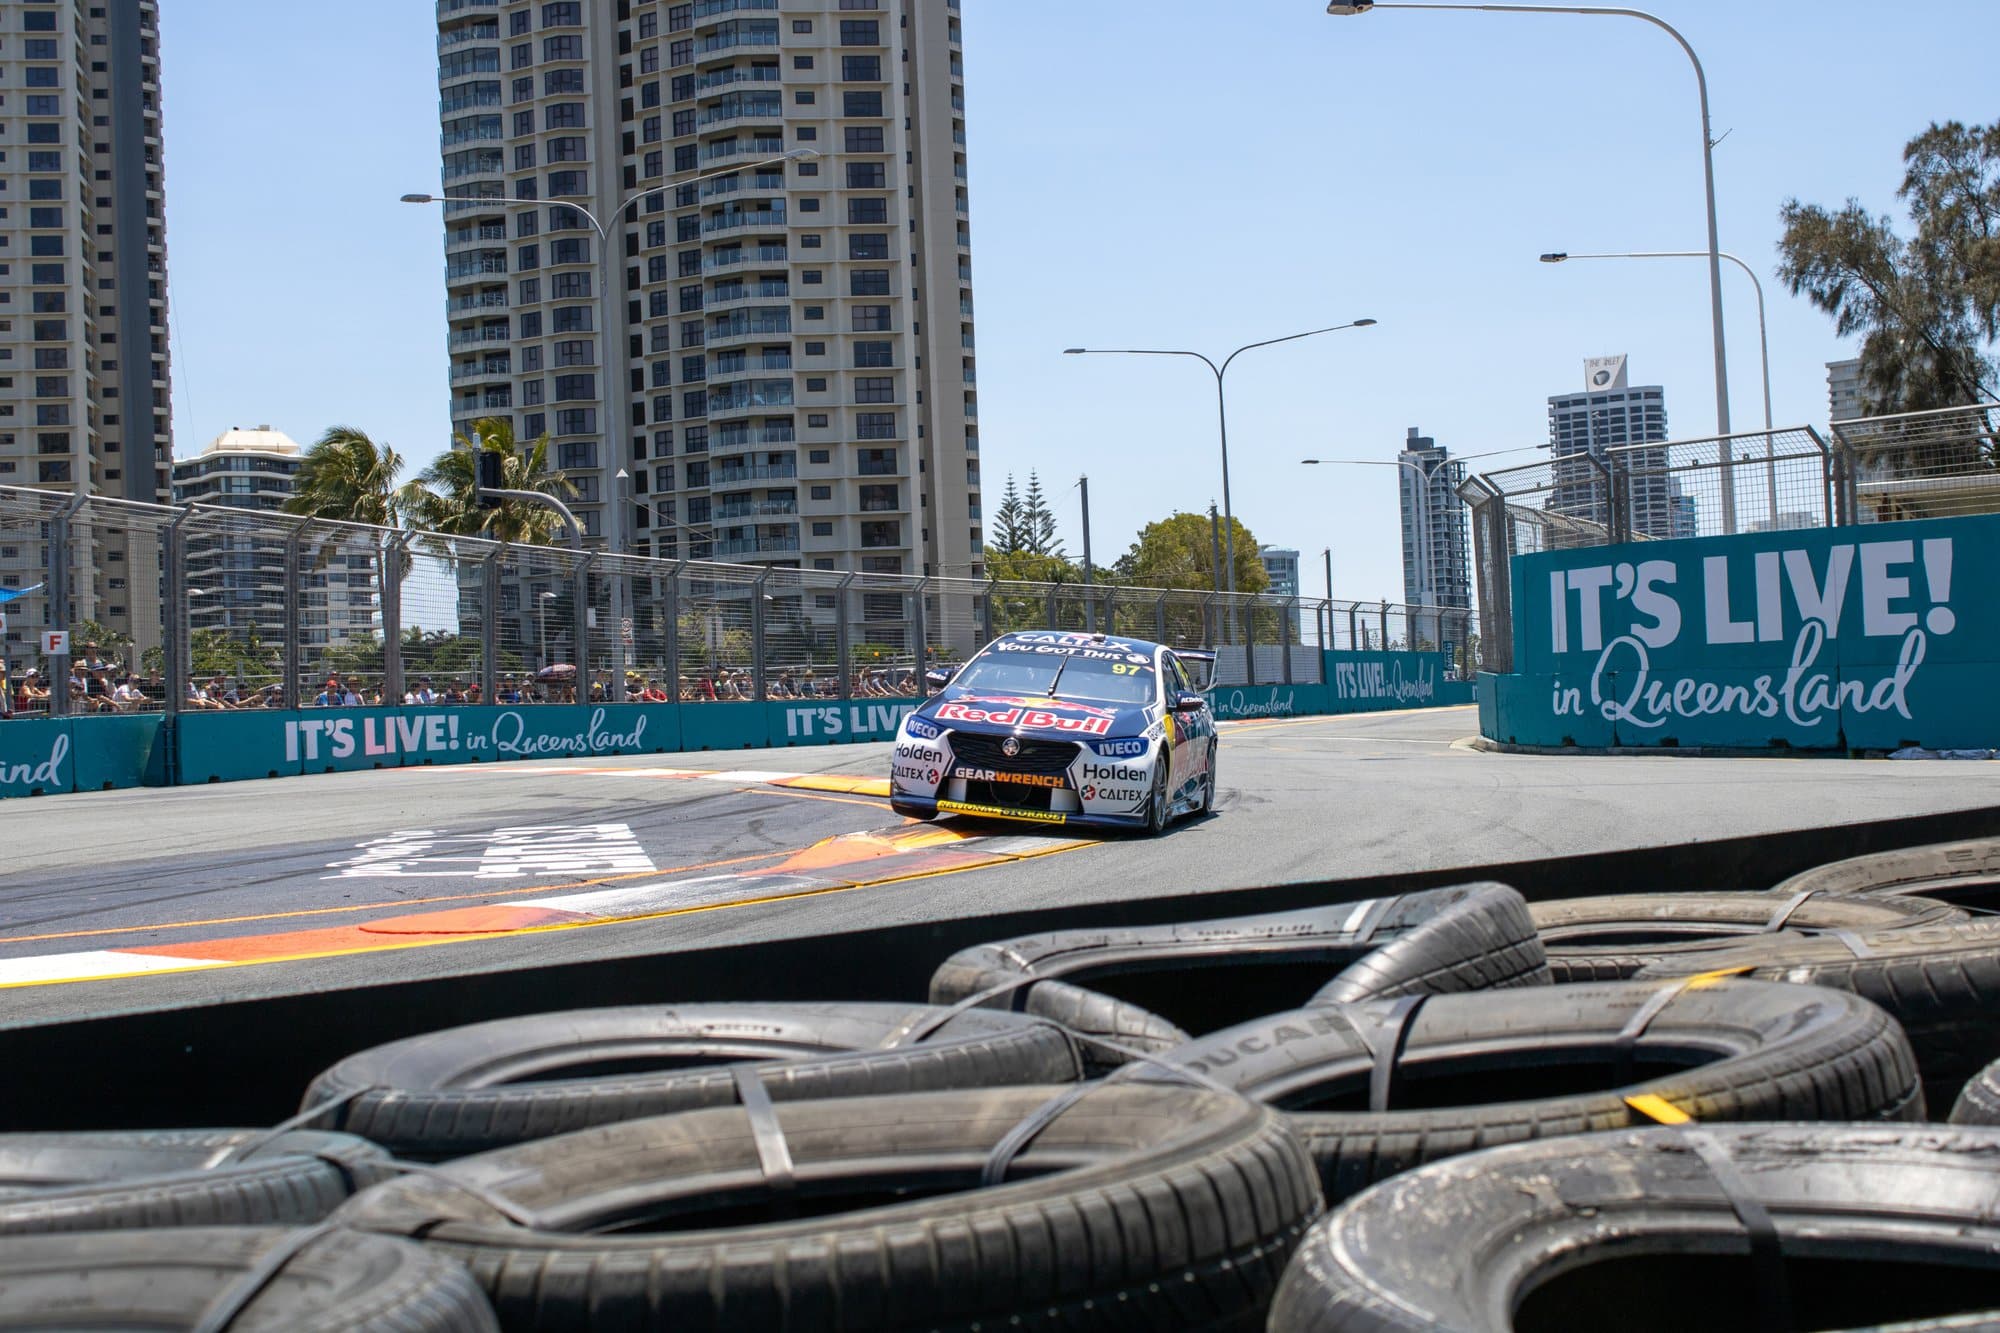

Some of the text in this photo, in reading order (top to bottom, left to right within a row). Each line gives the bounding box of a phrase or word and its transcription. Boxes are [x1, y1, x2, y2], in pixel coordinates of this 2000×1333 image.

[1550, 538, 1956, 653] IT'S LIVE!
[49, 635, 62, 651] F
[1015, 634, 1133, 652] CALTEX
[1112, 664, 1141, 675] 97
[1336, 663, 1357, 699] IT'S
[1357, 663, 1385, 698] LIVE!
[1393, 657, 1434, 703] Queensland
[1553, 617, 1926, 728] in Queensland
[1219, 699, 1229, 713] in
[1231, 687, 1294, 715] Queensland
[786, 707, 843, 736] IT'S
[907, 720, 938, 738] IVECO
[935, 704, 1114, 735] Red Bull
[285, 707, 647, 762] IT'S LIVE! in Queensland
[1099, 741, 1142, 755] IVECO
[955, 767, 1064, 788] GEARWRENCH
[1083, 763, 1147, 782] Holden
[1098, 788, 1142, 801] CALTEX
